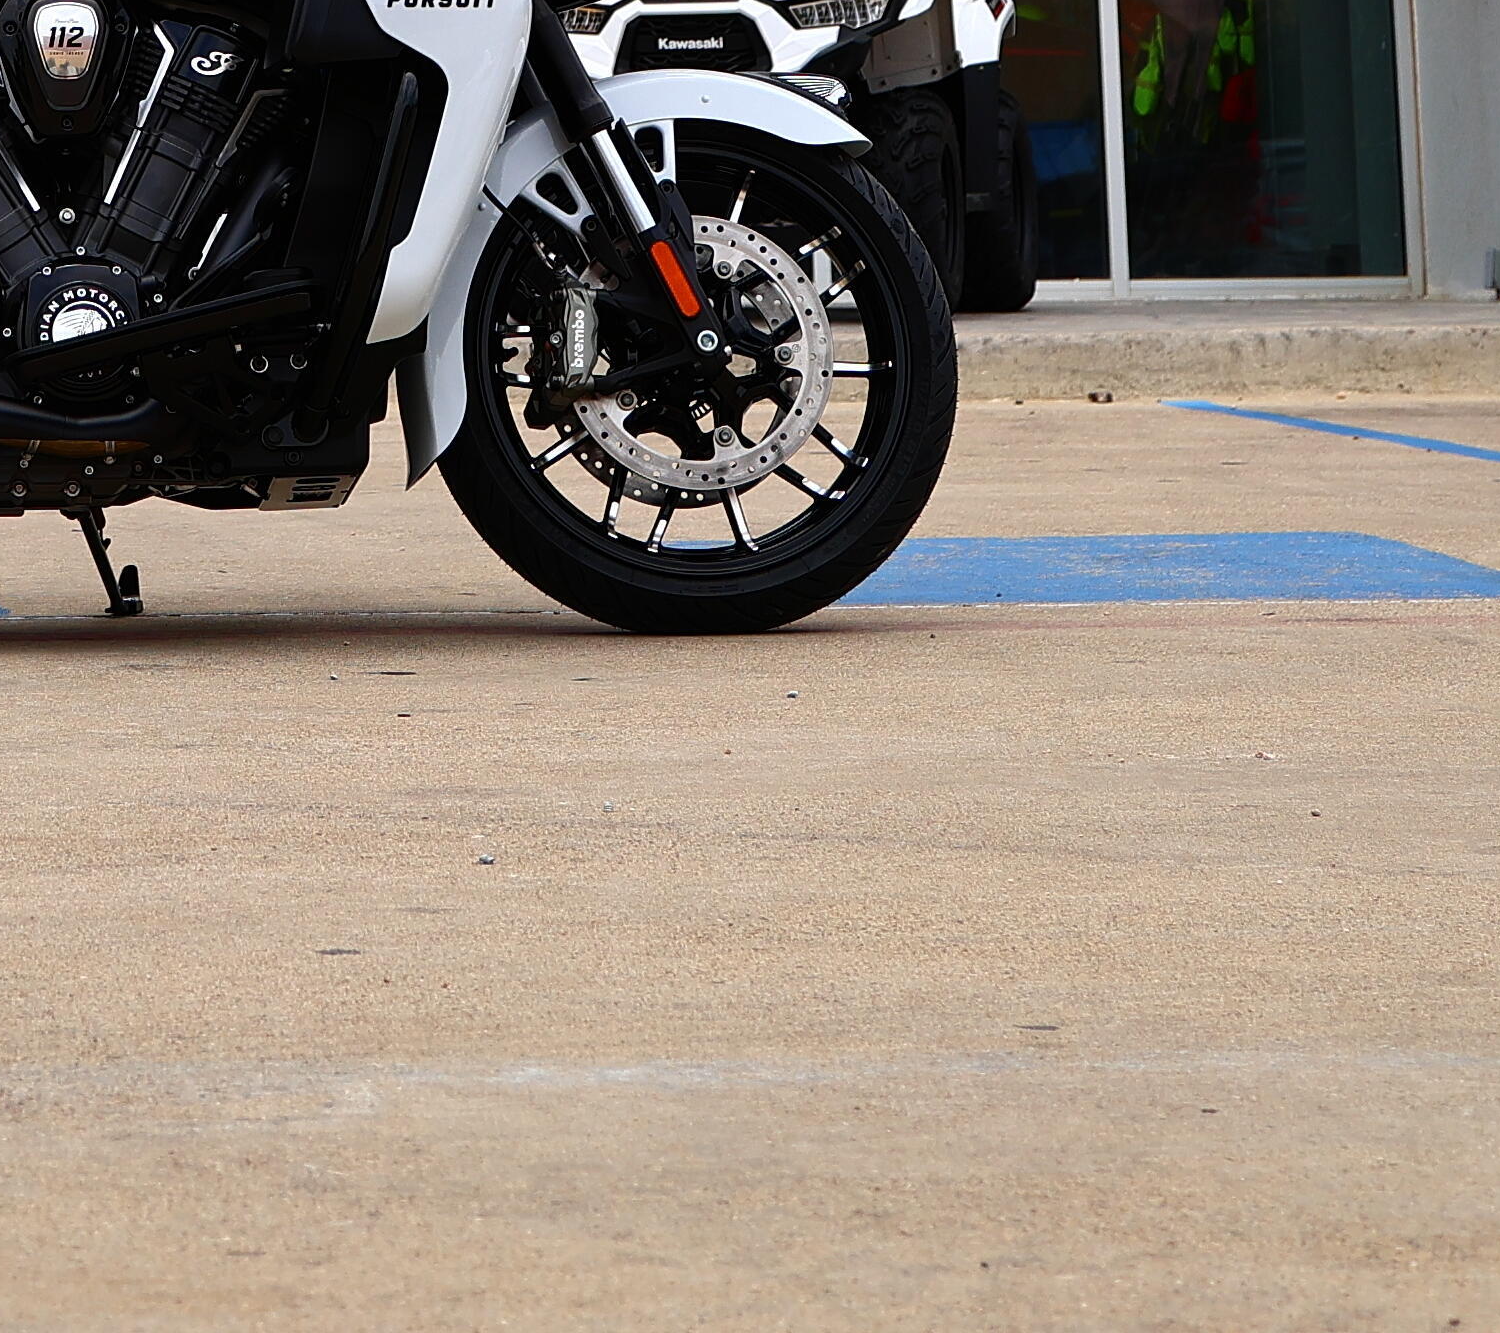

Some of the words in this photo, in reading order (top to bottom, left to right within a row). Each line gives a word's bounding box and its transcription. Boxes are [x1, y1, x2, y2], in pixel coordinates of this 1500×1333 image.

[49, 27, 84, 48] 112
[658, 36, 723, 50] Kawasaki
[40, 300, 60, 341] DIAN
[63, 288, 128, 325] MOTORC
[571, 309, 585, 368] brembo
